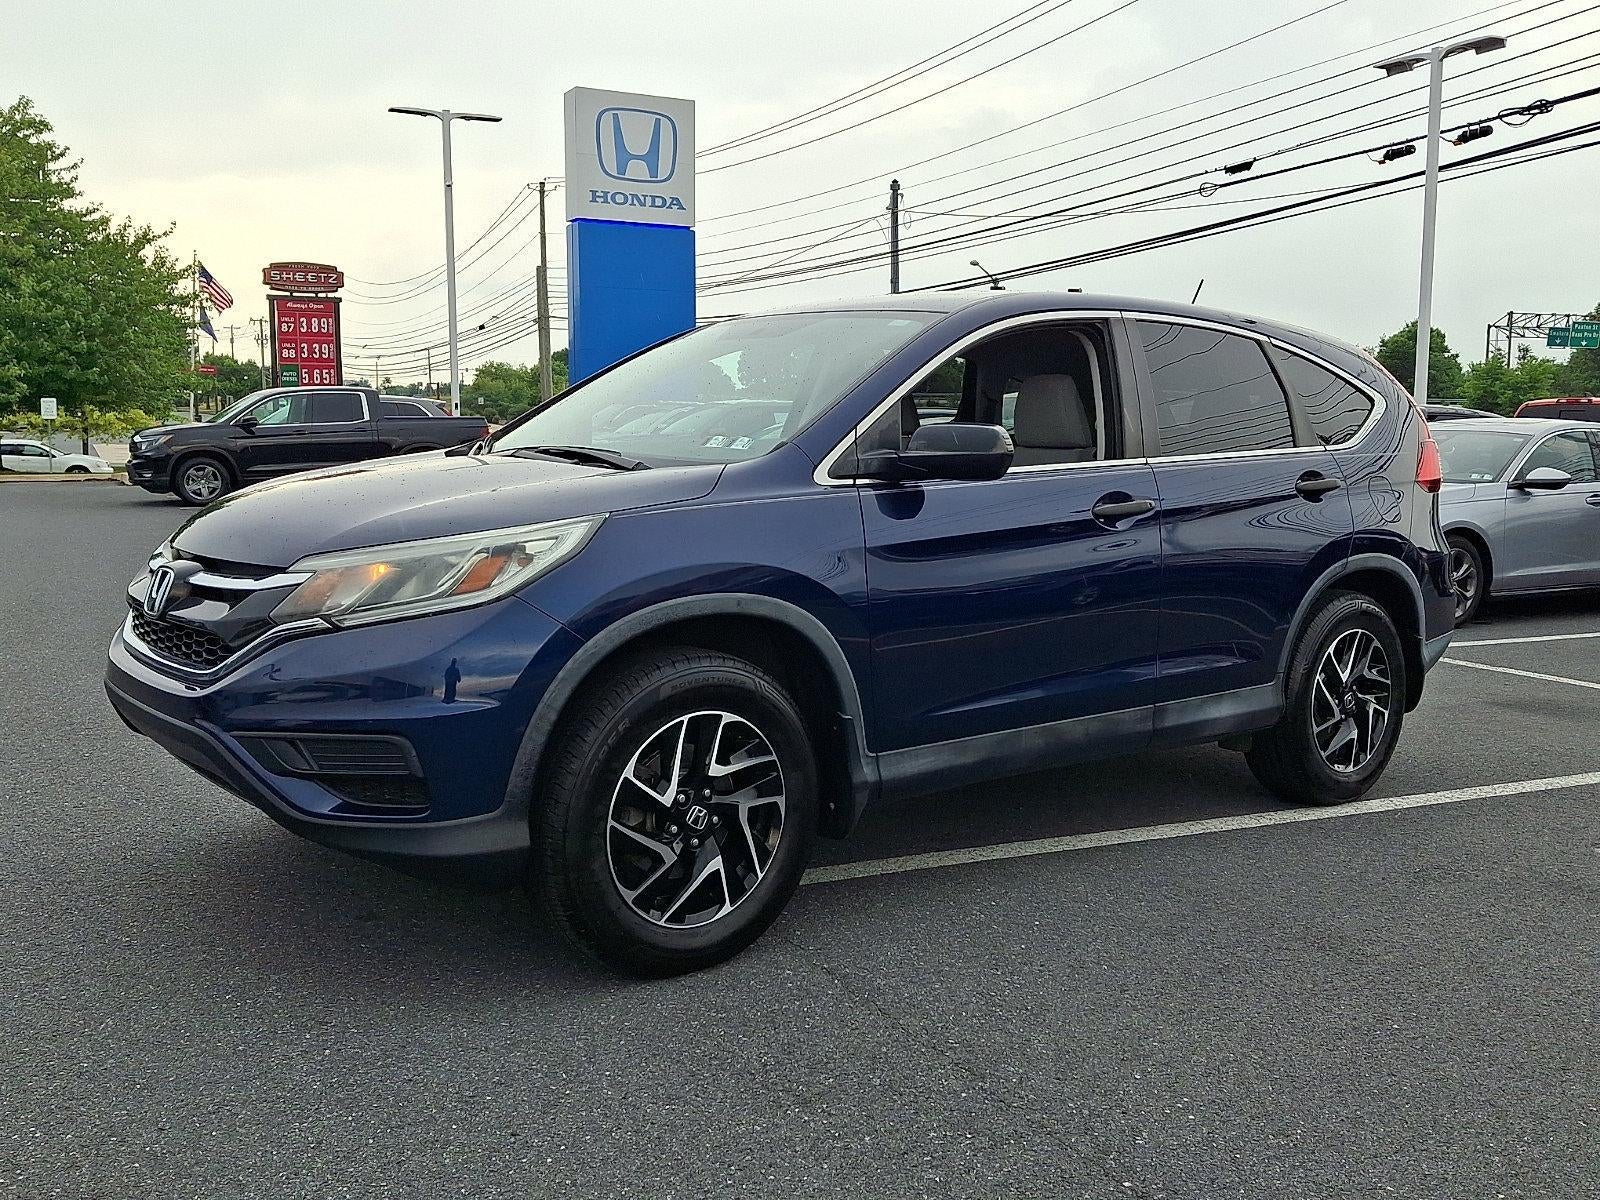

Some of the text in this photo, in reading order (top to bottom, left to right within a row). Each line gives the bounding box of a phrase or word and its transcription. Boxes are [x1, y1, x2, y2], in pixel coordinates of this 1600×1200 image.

[589, 189, 686, 211] HONDA
[270, 270, 338, 284] SHEETZ
[286, 302, 325, 310] Always Open
[281, 323, 295, 333] 87
[282, 349, 296, 358] 88
